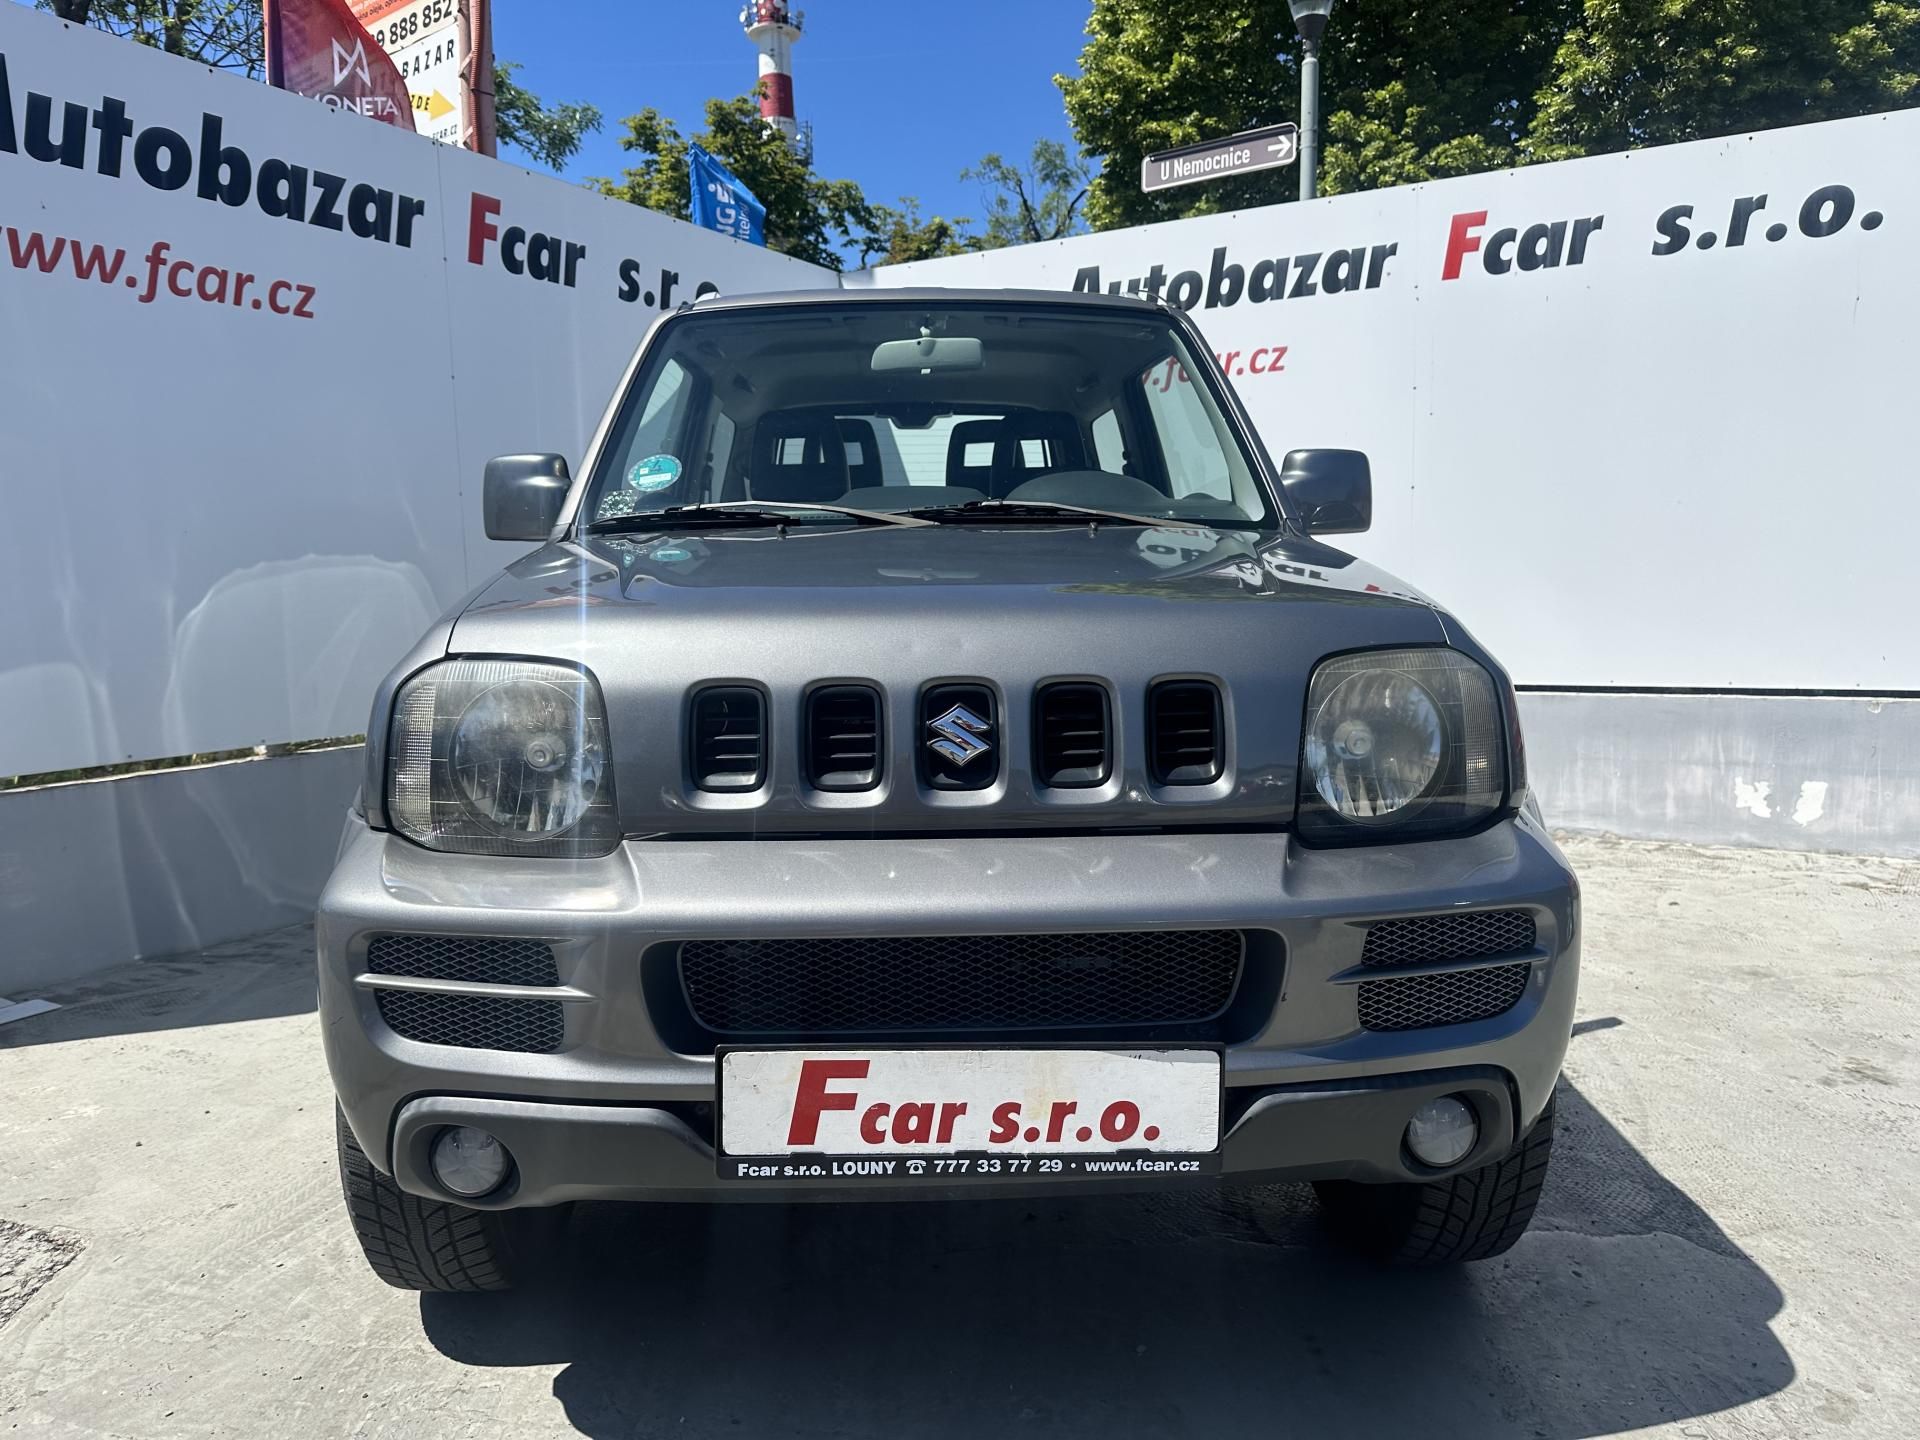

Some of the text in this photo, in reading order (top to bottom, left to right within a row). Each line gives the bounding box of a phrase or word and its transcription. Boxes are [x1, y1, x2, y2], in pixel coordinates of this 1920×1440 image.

[373, 0, 452, 47] 9 888 852
[1160, 146, 1251, 181] U Nemocnice
[0, 226, 316, 319] ww.fcar.cz
[467, 191, 586, 289] Fcar
[1441, 210, 1604, 282] Fcar
[1652, 184, 1884, 257] s.r.o.
[786, 1059, 1160, 1146] Fcar s.r.o.
[738, 1158, 1200, 1177] Fcar s.r.o. LOUNY 777 33 77 29 www.fcar.cz
